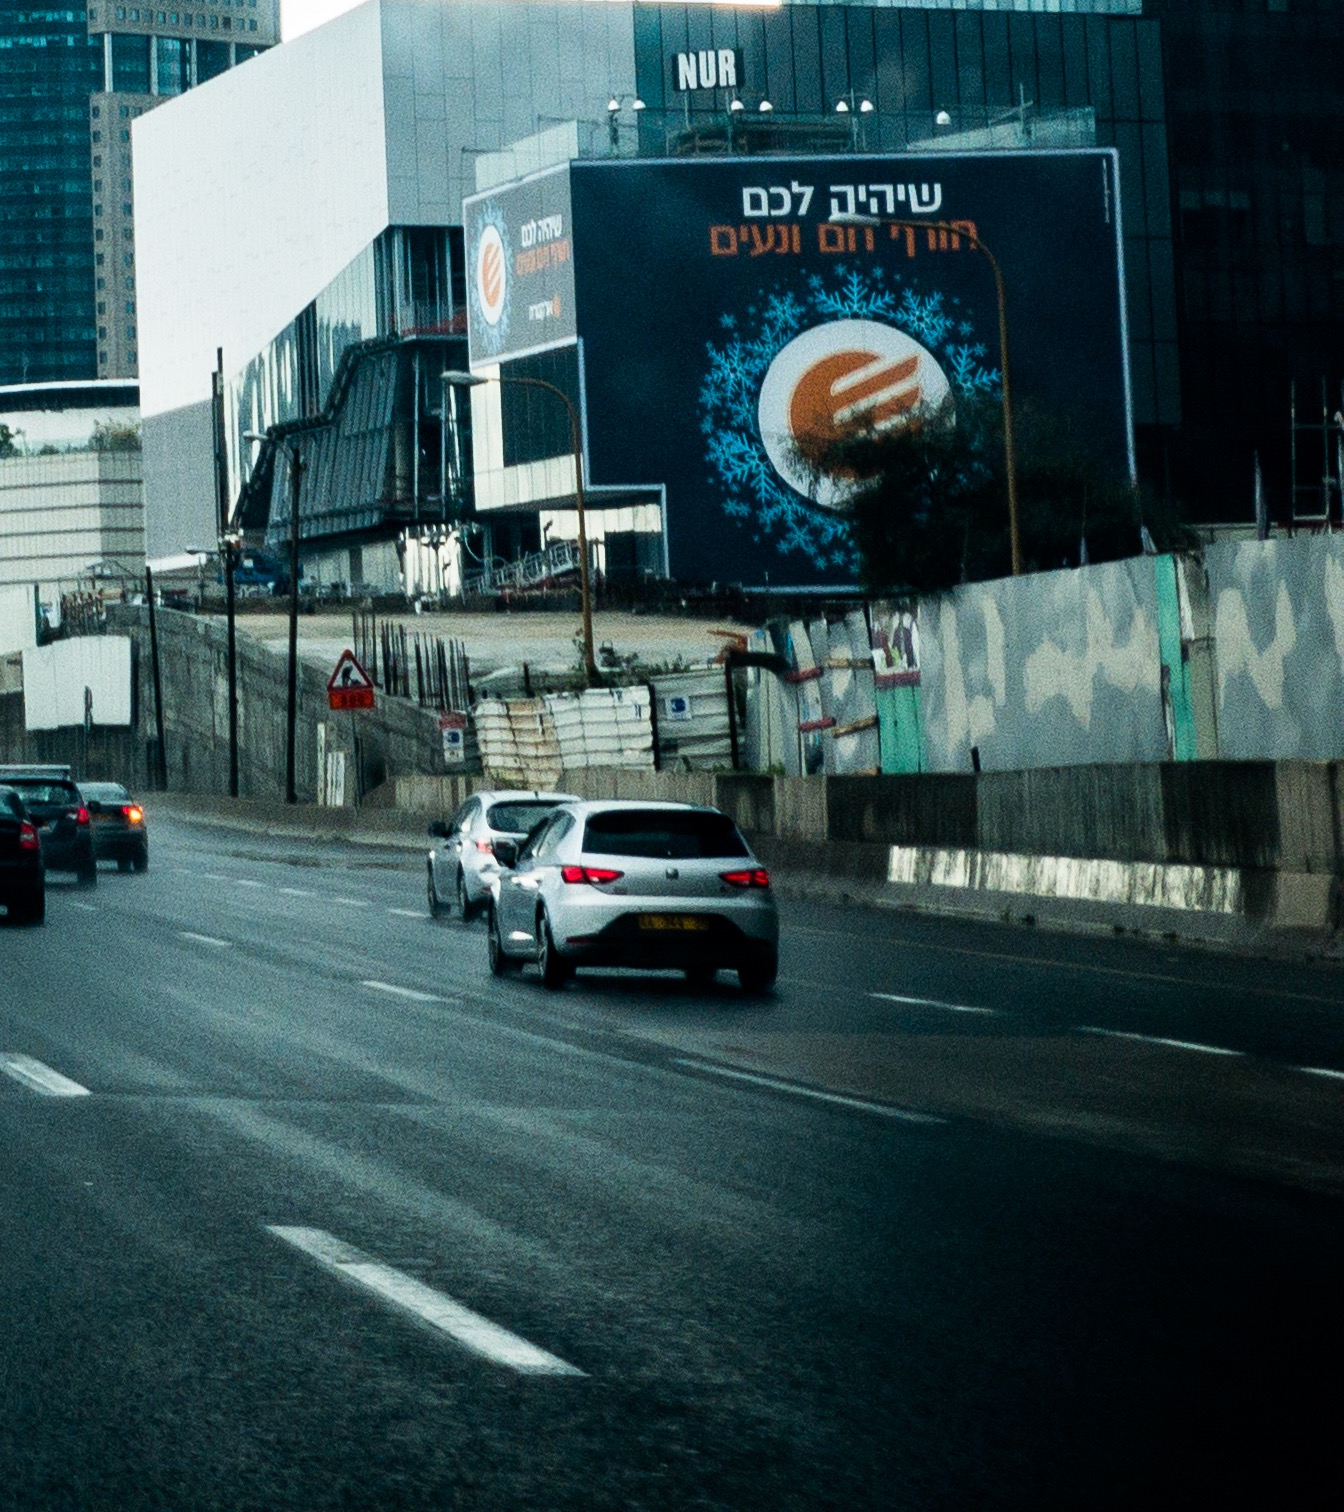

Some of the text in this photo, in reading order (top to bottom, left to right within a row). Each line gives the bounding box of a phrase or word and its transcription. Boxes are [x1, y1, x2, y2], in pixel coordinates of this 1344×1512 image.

[677, 49, 737, 90] NUR
[742, 180, 942, 216] שיהיה לכם
[710, 222, 801, 256] ונעים
[889, 220, 979, 258] חורף
